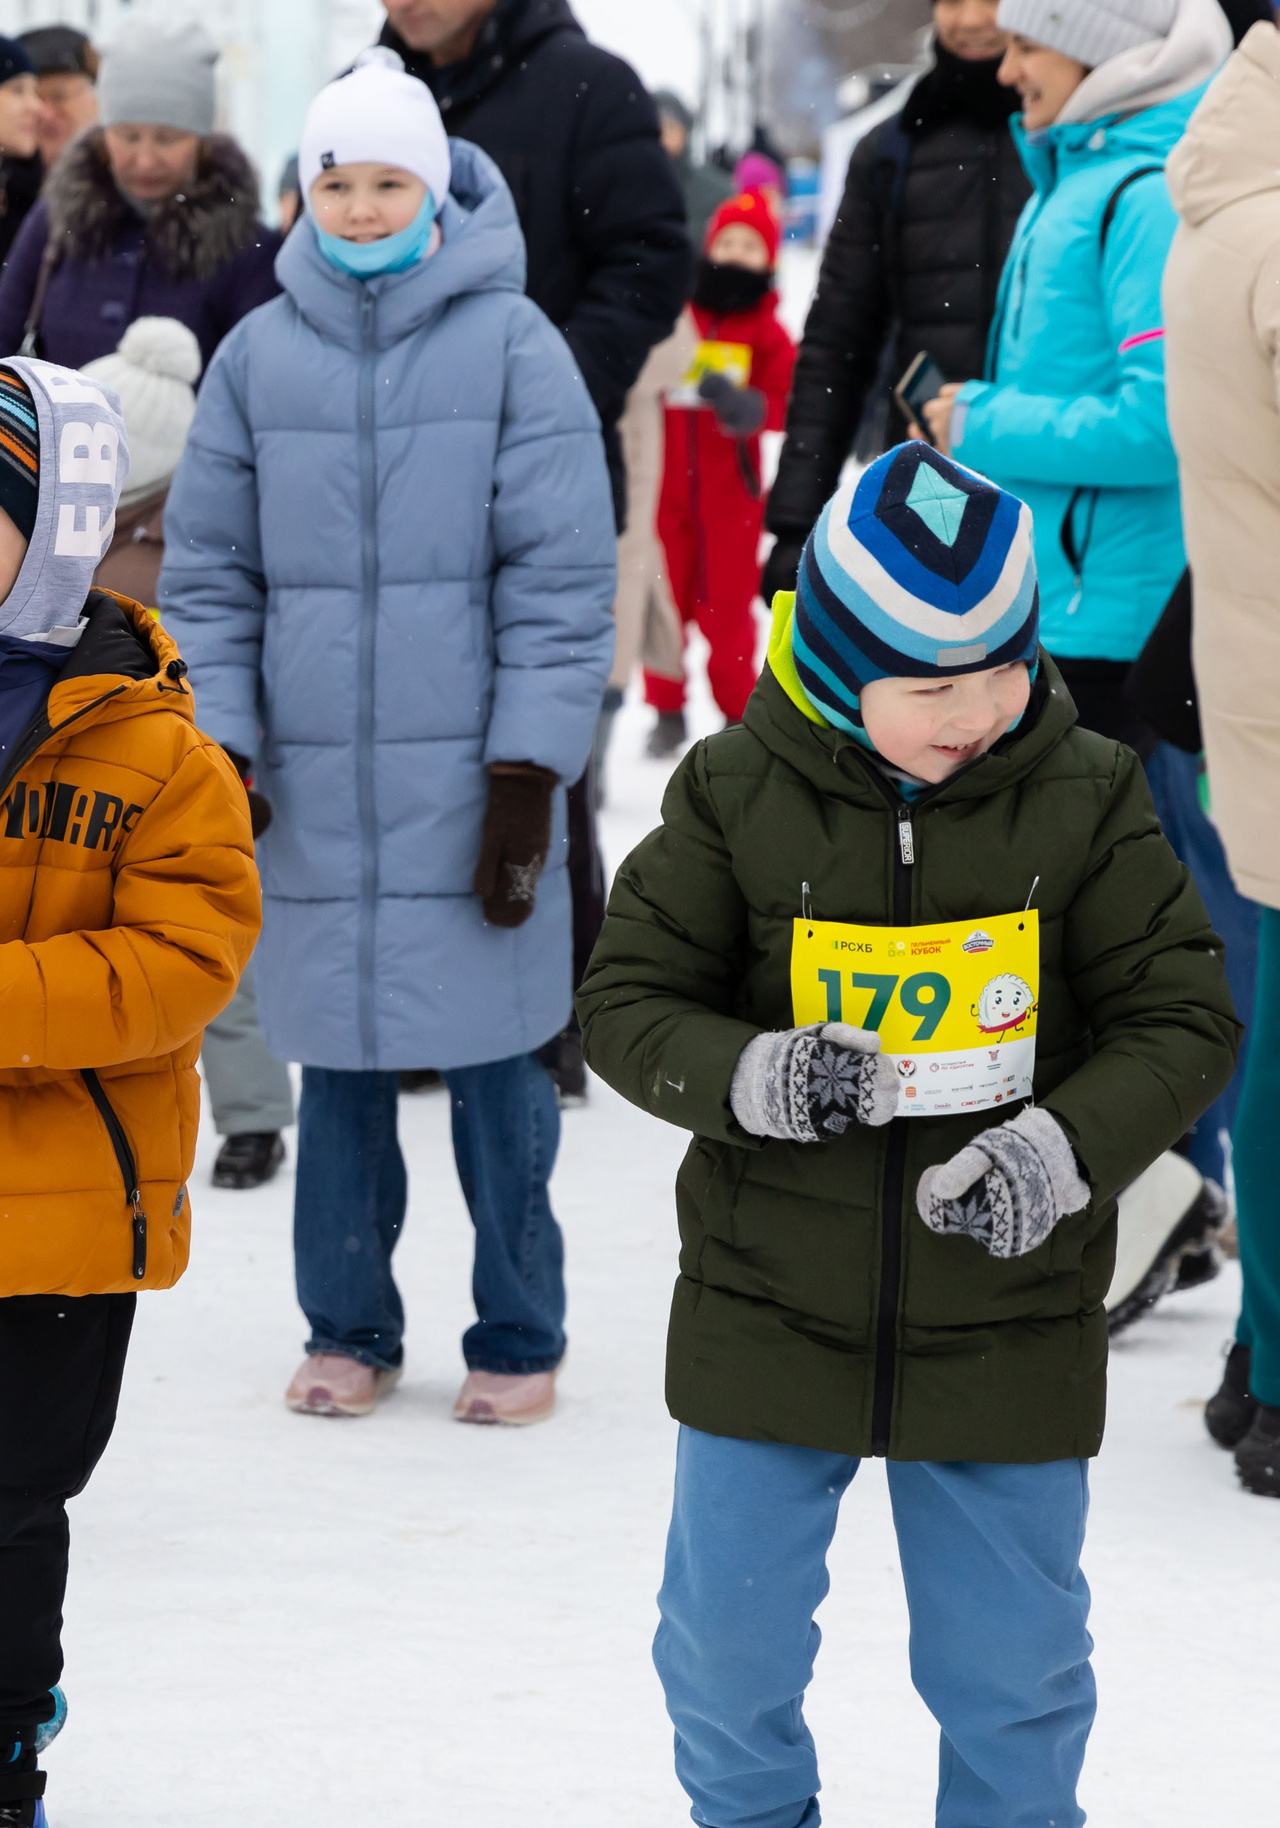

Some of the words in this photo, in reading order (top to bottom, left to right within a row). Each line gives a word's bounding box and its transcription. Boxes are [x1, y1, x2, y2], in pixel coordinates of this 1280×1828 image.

[901, 824, 912, 862] SUPERIOR
[840, 941, 873, 953] РСХБ
[910, 938, 951, 947] ПЕЛЬМЕННЫЙ
[963, 940, 993, 951] ВОСТОЧНЫЙ
[911, 946, 941, 956] КУБОК
[818, 968, 951, 1041] 179
